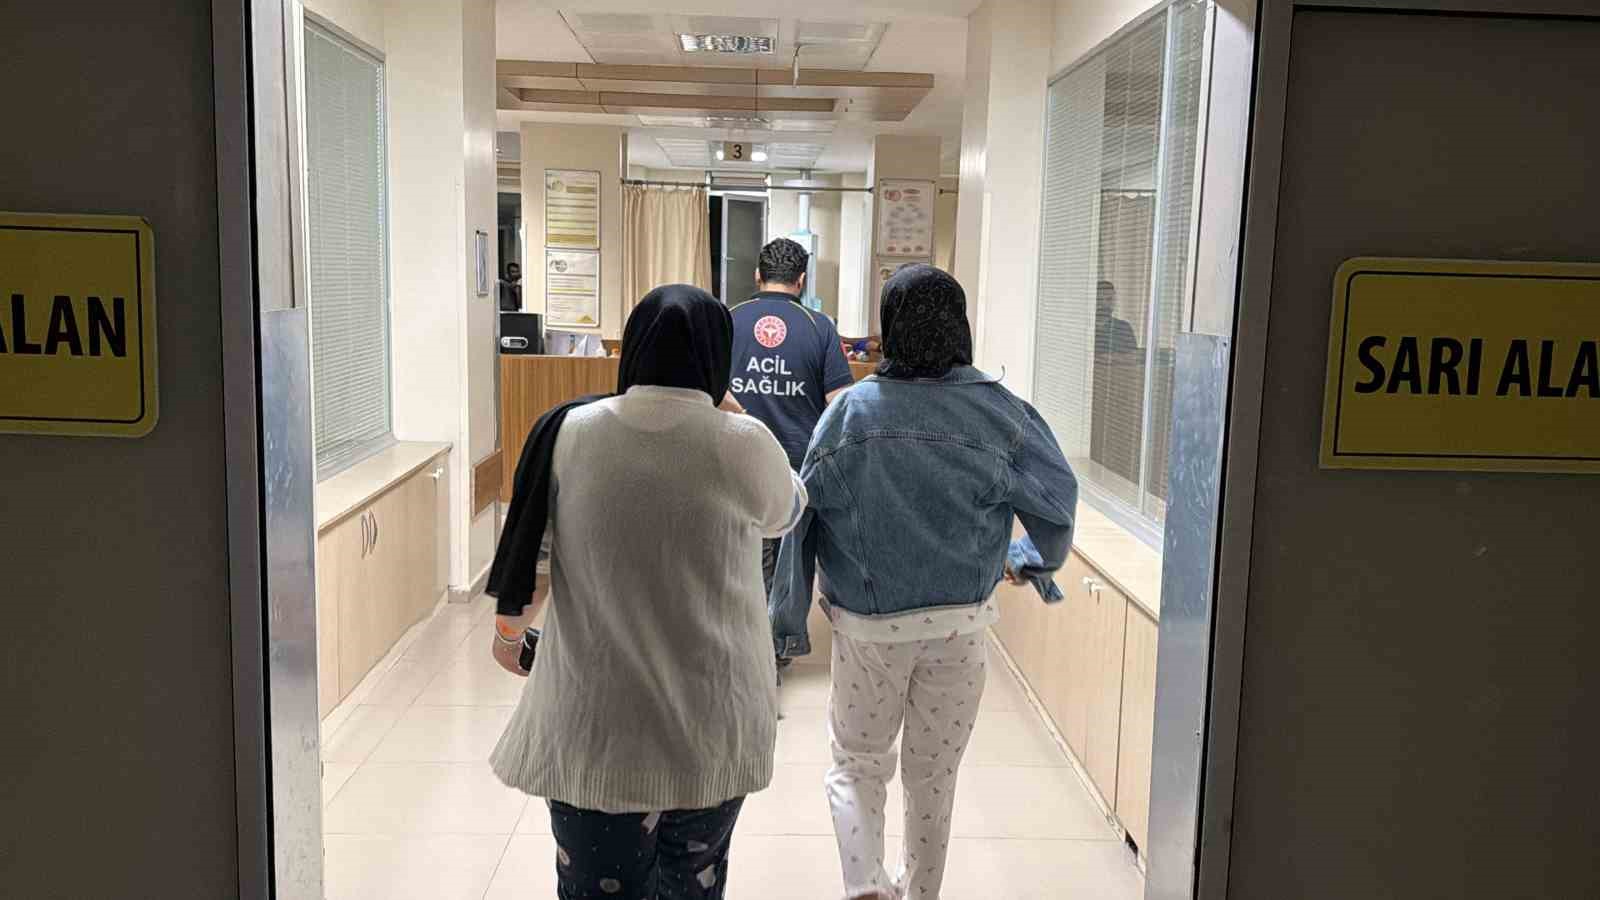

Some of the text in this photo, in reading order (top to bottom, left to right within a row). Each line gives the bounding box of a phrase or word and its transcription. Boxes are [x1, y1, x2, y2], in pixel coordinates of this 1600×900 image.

[733, 144, 742, 159] 3
[0, 293, 127, 358] LAN
[746, 355, 792, 375] ACİL
[1354, 335, 1483, 396] SARI
[731, 376, 806, 396] SAĞLIK
